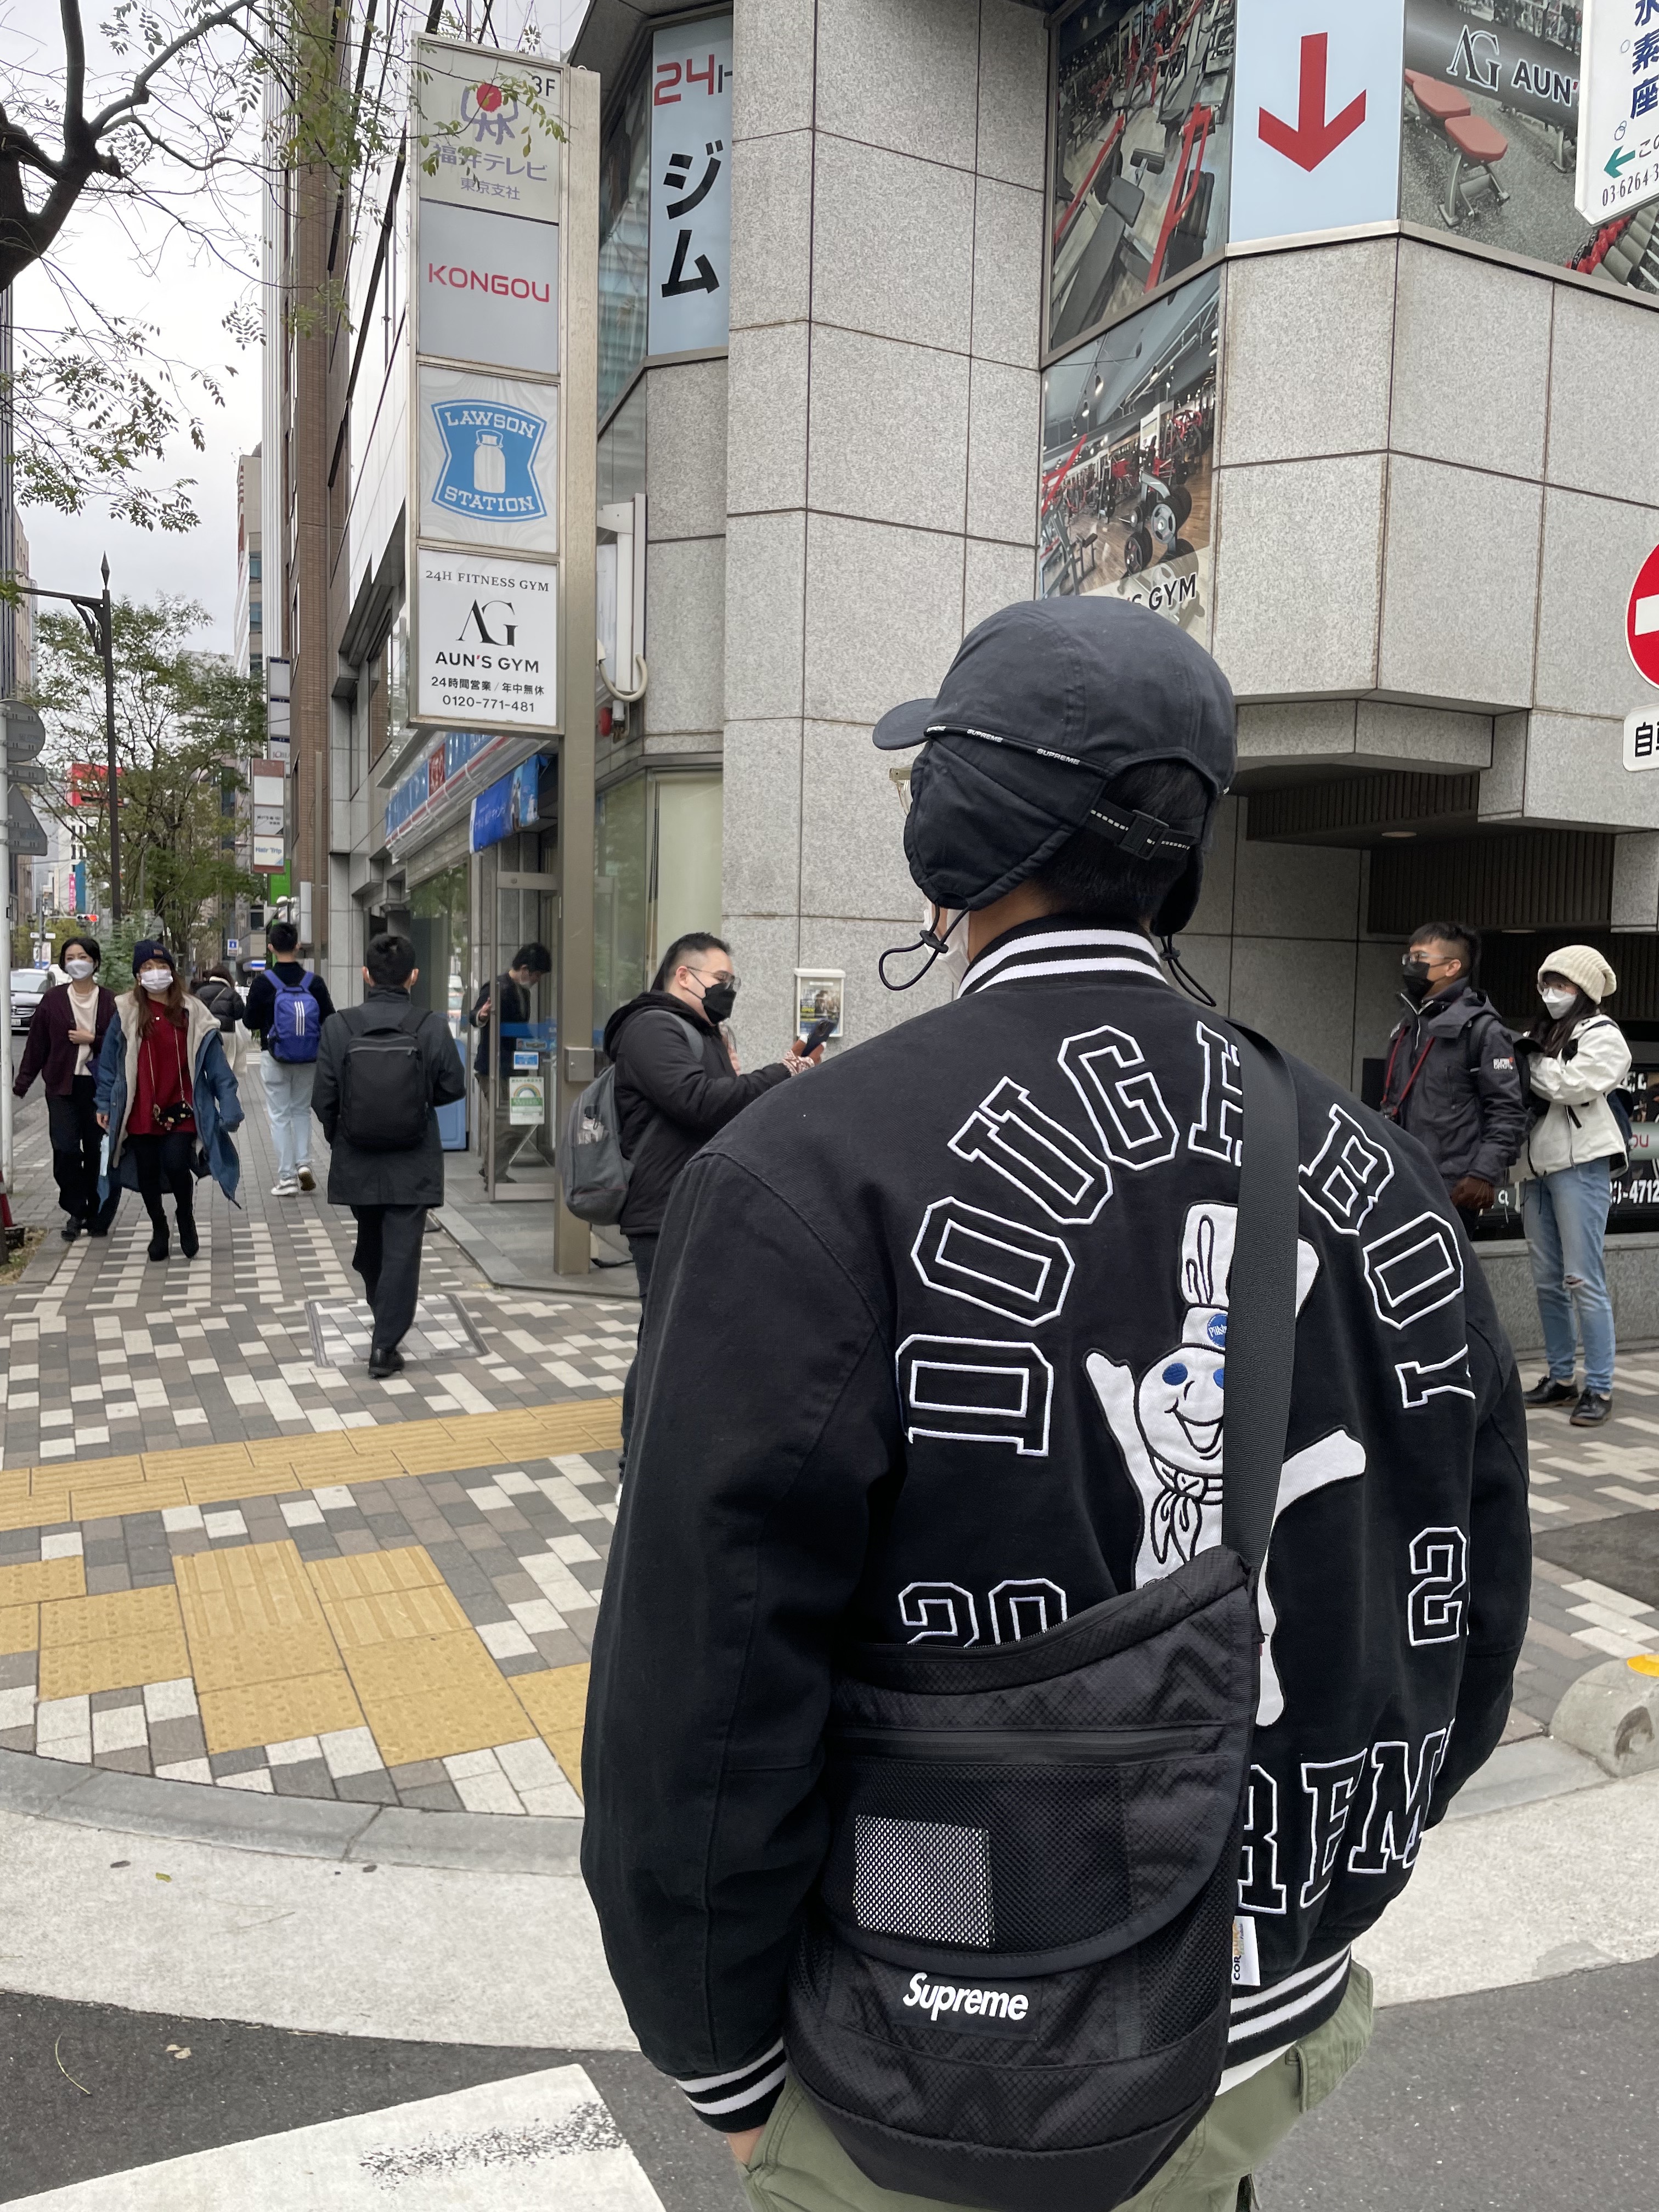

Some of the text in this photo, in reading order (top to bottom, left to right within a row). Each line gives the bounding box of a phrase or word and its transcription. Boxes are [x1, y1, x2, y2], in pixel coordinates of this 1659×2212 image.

[531, 75, 556, 97] 3F
[1639, 136, 1659, 158] こ
[433, 143, 548, 182] 福井テレビ
[460, 177, 521, 200] 東京支社
[662, 139, 724, 297] ジム
[428, 263, 549, 303] KONGOU
[444, 410, 537, 439] LAWSON
[443, 485, 535, 512] STATION
[426, 571, 549, 591] 24H FITNESS GYM
[1149, 573, 1196, 611] GYM
[435, 651, 539, 673] AUN'S GYM
[442, 695, 534, 713] 0120-771-481
[967, 729, 1003, 743] SUPREME
[1635, 721, 1659, 758] 自
[1036, 748, 1081, 765] SUPREME
[902, 1972, 1029, 2021] Supreme
